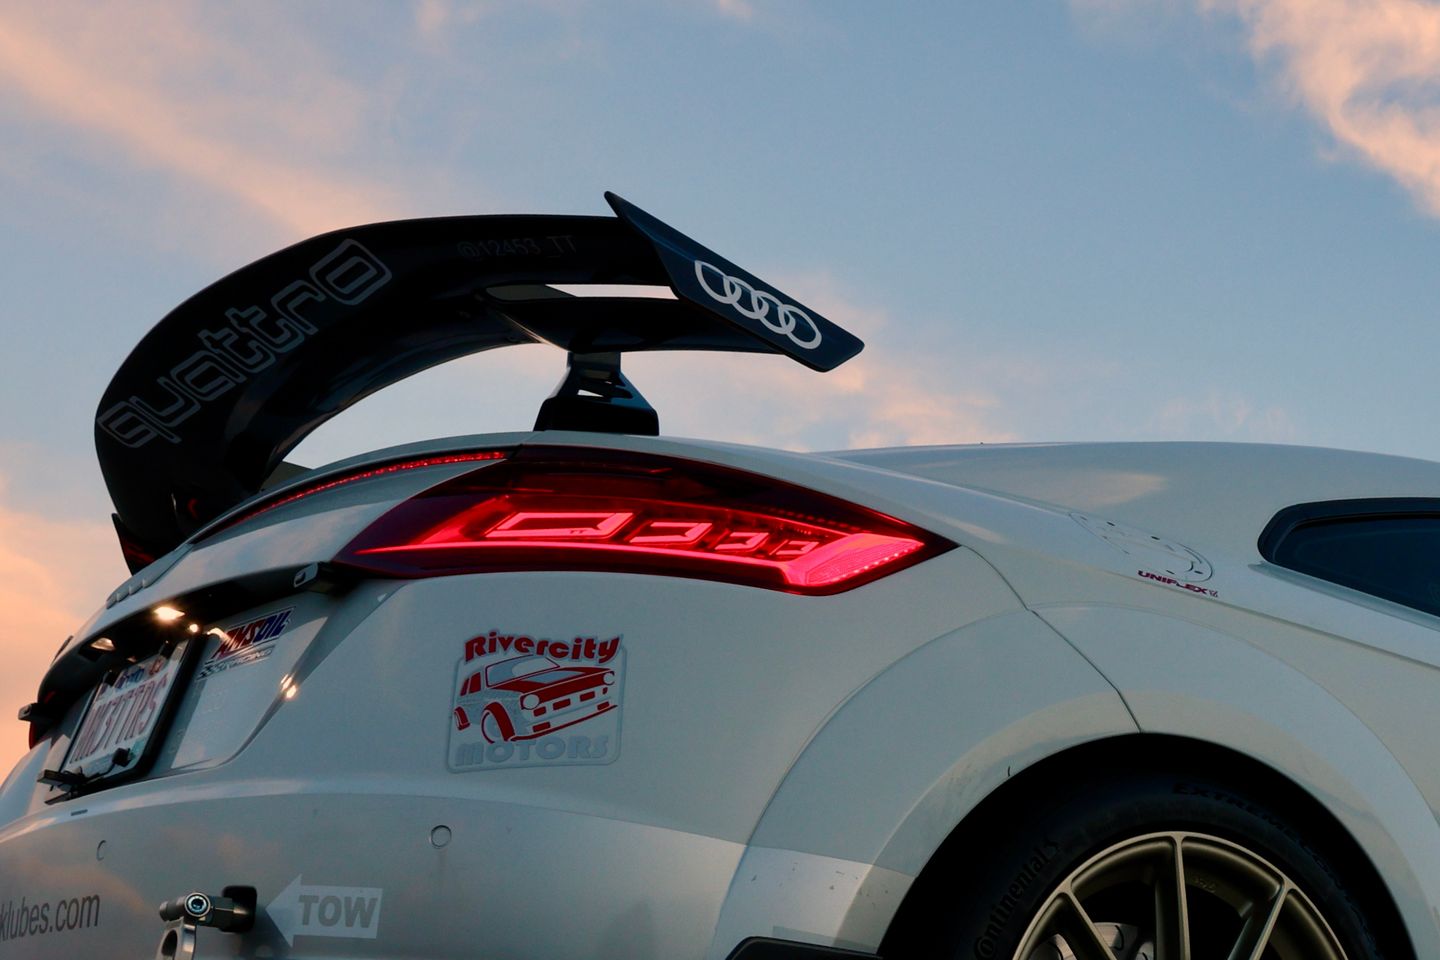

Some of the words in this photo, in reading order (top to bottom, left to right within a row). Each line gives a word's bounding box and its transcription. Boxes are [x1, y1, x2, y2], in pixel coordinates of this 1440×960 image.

[96, 238, 393, 448] quattro
[1137, 569, 1208, 594] UNIFLEX
[211, 610, 292, 661] AMSOIL
[464, 629, 620, 664] Rivercity
[453, 735, 609, 767] MOTORS
[299, 894, 379, 928] TOW
